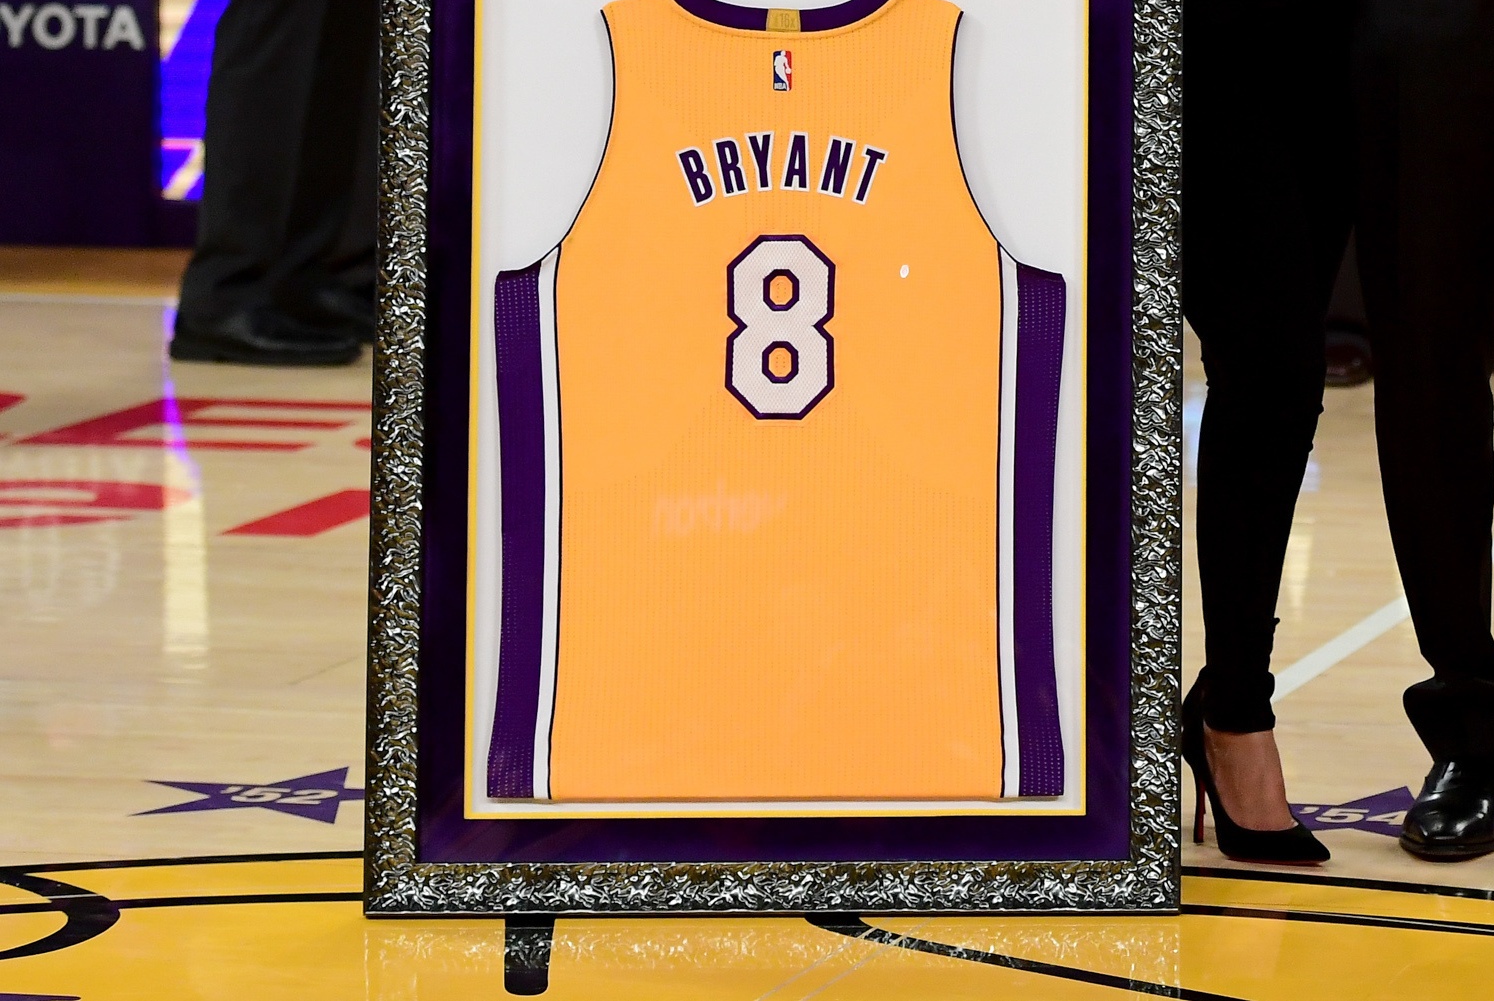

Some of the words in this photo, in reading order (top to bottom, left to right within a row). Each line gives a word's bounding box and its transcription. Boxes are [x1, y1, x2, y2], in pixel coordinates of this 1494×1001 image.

[676, 130, 887, 206] BRYANT
[725, 234, 835, 420] 8
[220, 785, 339, 805] '52
[1299, 805, 1409, 826] '54
